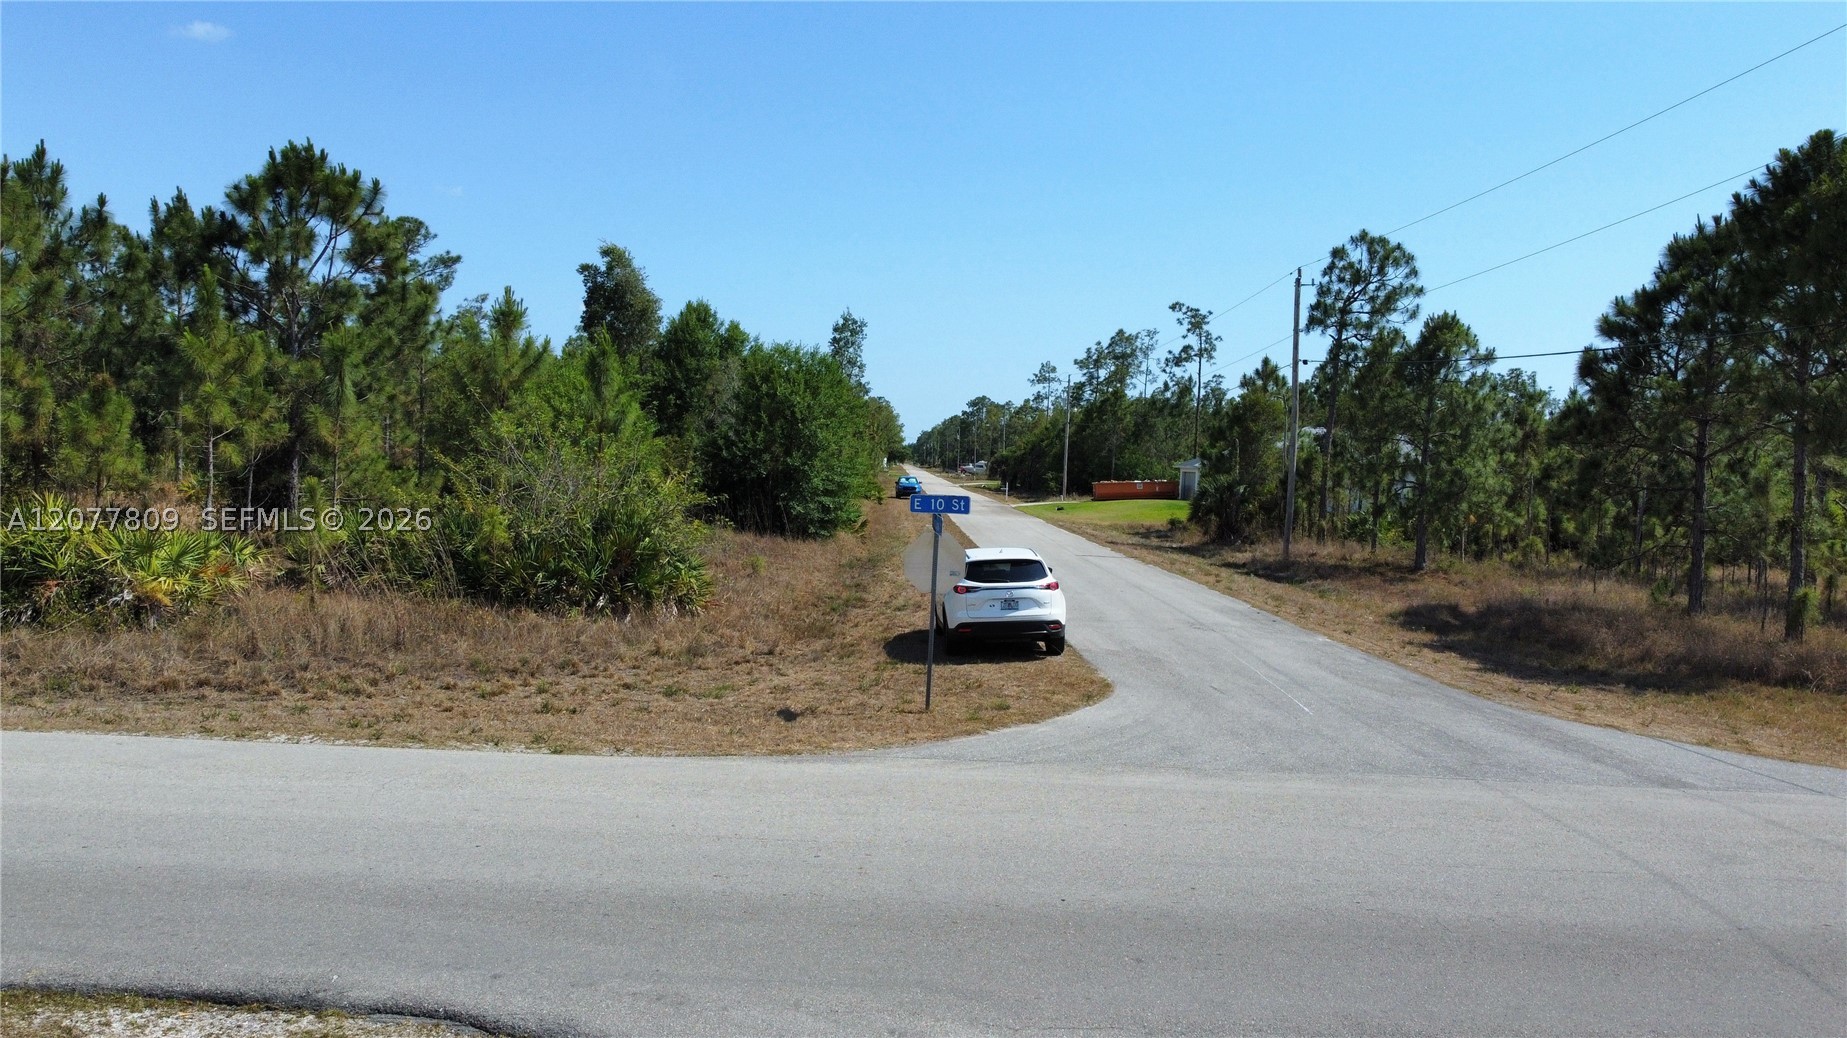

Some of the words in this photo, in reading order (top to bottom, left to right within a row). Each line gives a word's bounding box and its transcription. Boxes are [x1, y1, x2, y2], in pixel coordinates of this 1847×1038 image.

[914, 498, 922, 510] E
[931, 498, 945, 511] 10
[951, 499, 965, 511] St
